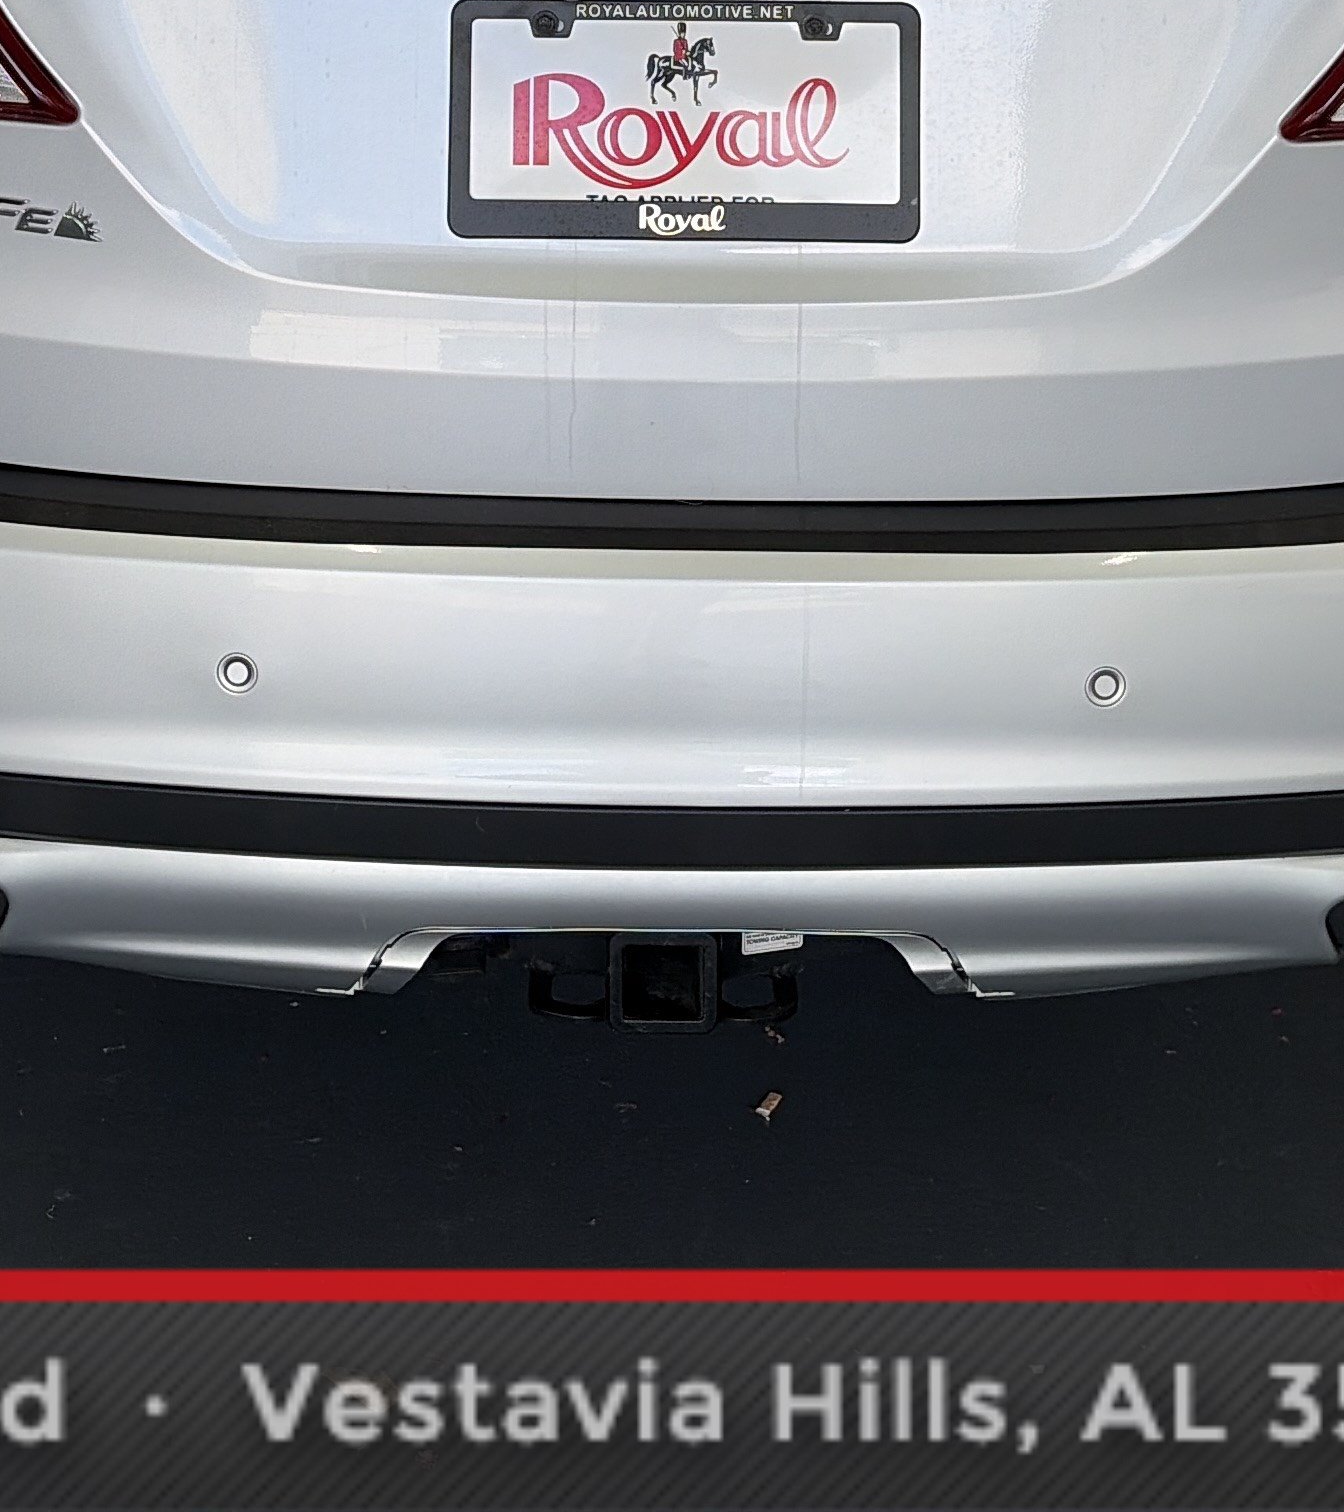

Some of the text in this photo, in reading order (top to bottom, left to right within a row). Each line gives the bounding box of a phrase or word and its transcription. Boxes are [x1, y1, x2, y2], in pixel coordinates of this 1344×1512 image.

[575, 4, 795, 21] ROYALAUTOMOTIVE.NET
[513, 73, 850, 190] Royal
[638, 203, 727, 236] Royal
